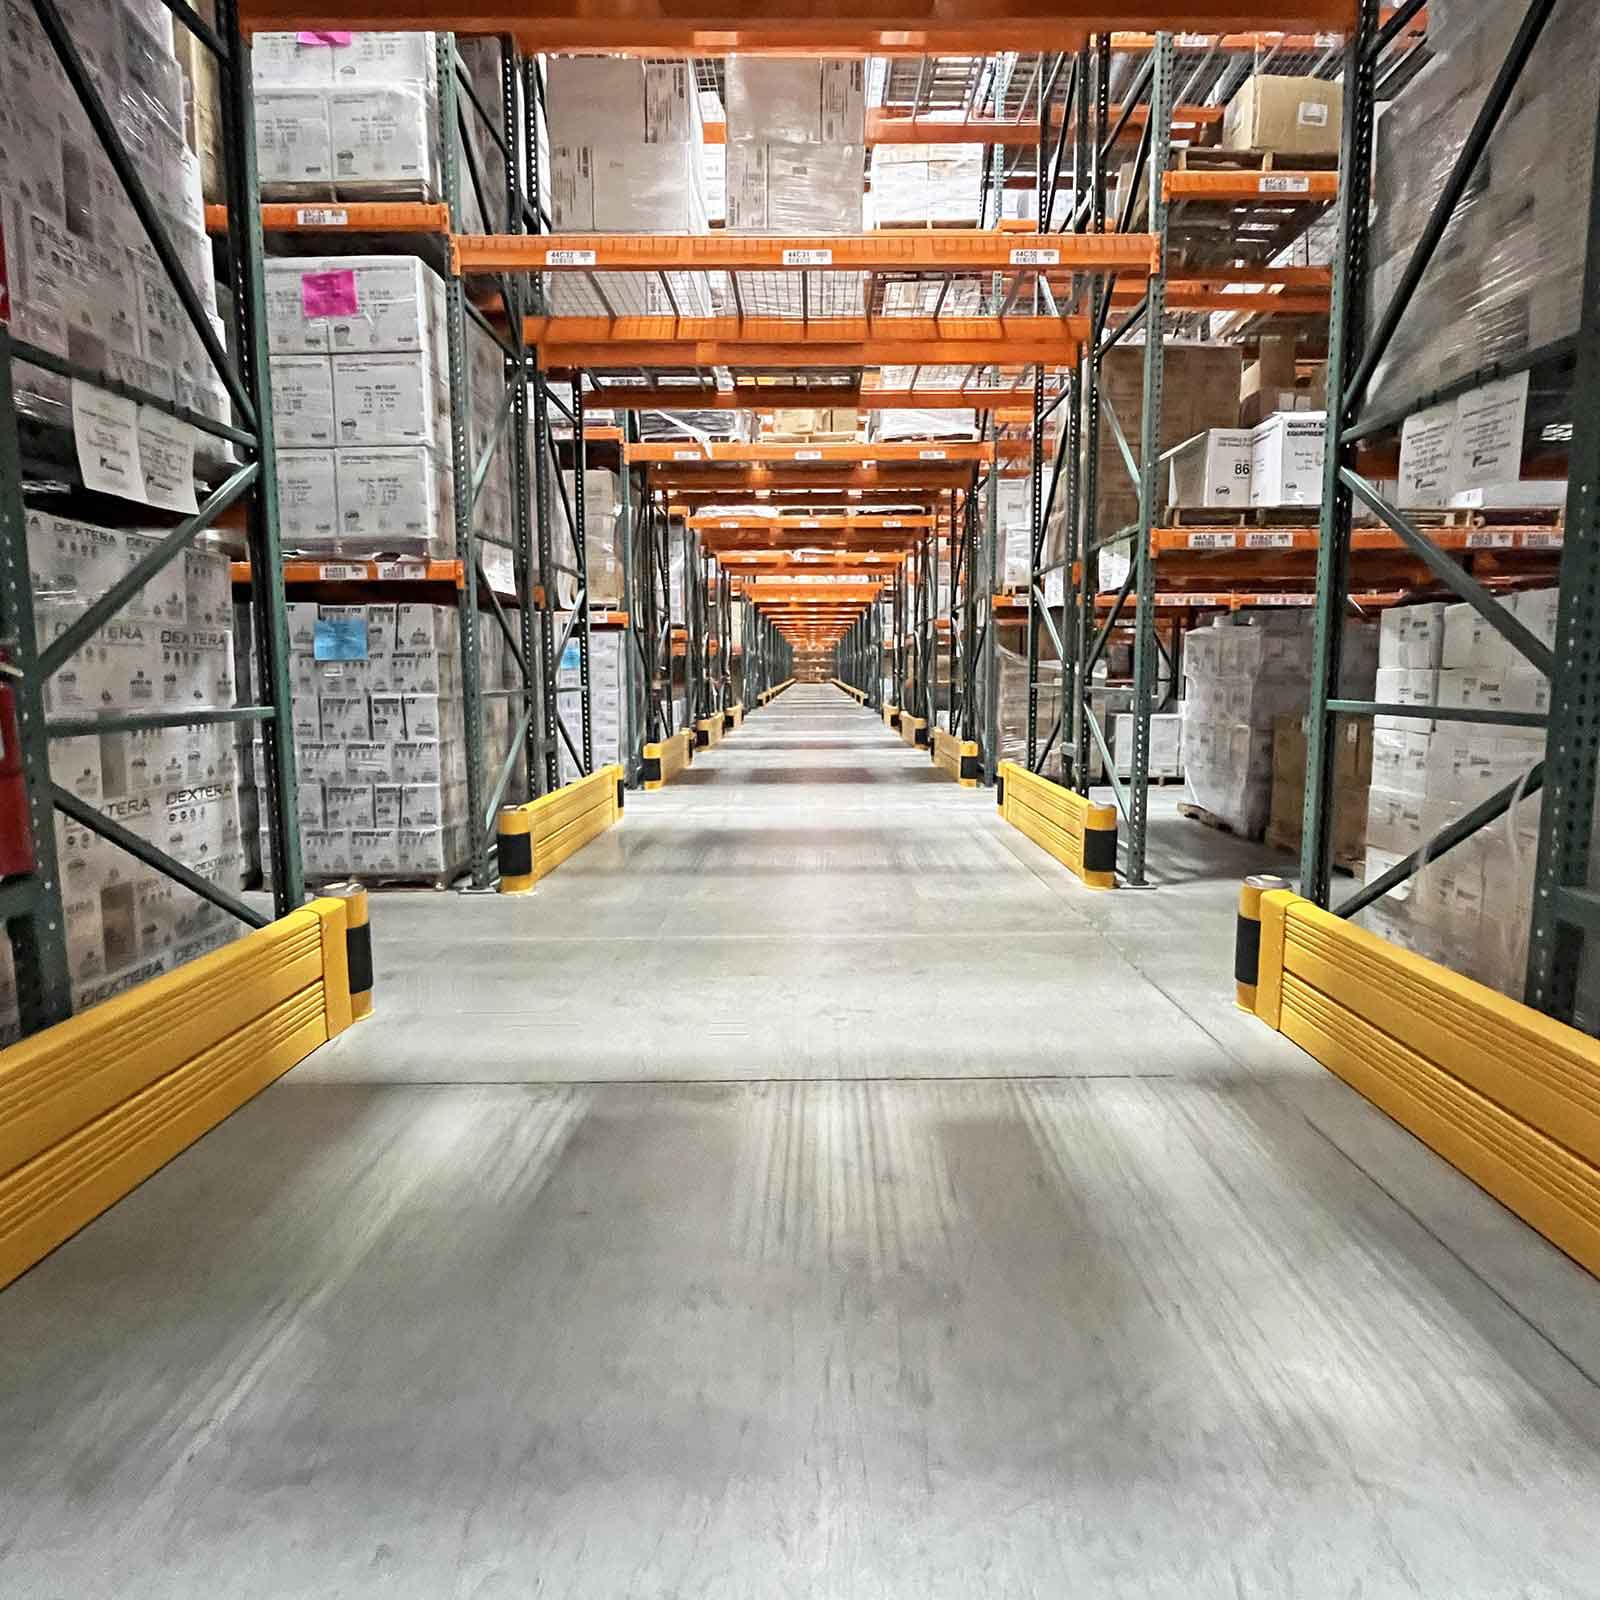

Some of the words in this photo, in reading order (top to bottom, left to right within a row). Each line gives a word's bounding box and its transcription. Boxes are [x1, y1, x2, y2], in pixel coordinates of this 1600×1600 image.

[1234, 463, 1250, 475] 86
[54, 522, 116, 545] DEXTERA
[55, 622, 144, 641] DTERA
[160, 630, 226, 646] DEXTERA
[166, 783, 232, 805] DEXTERA
